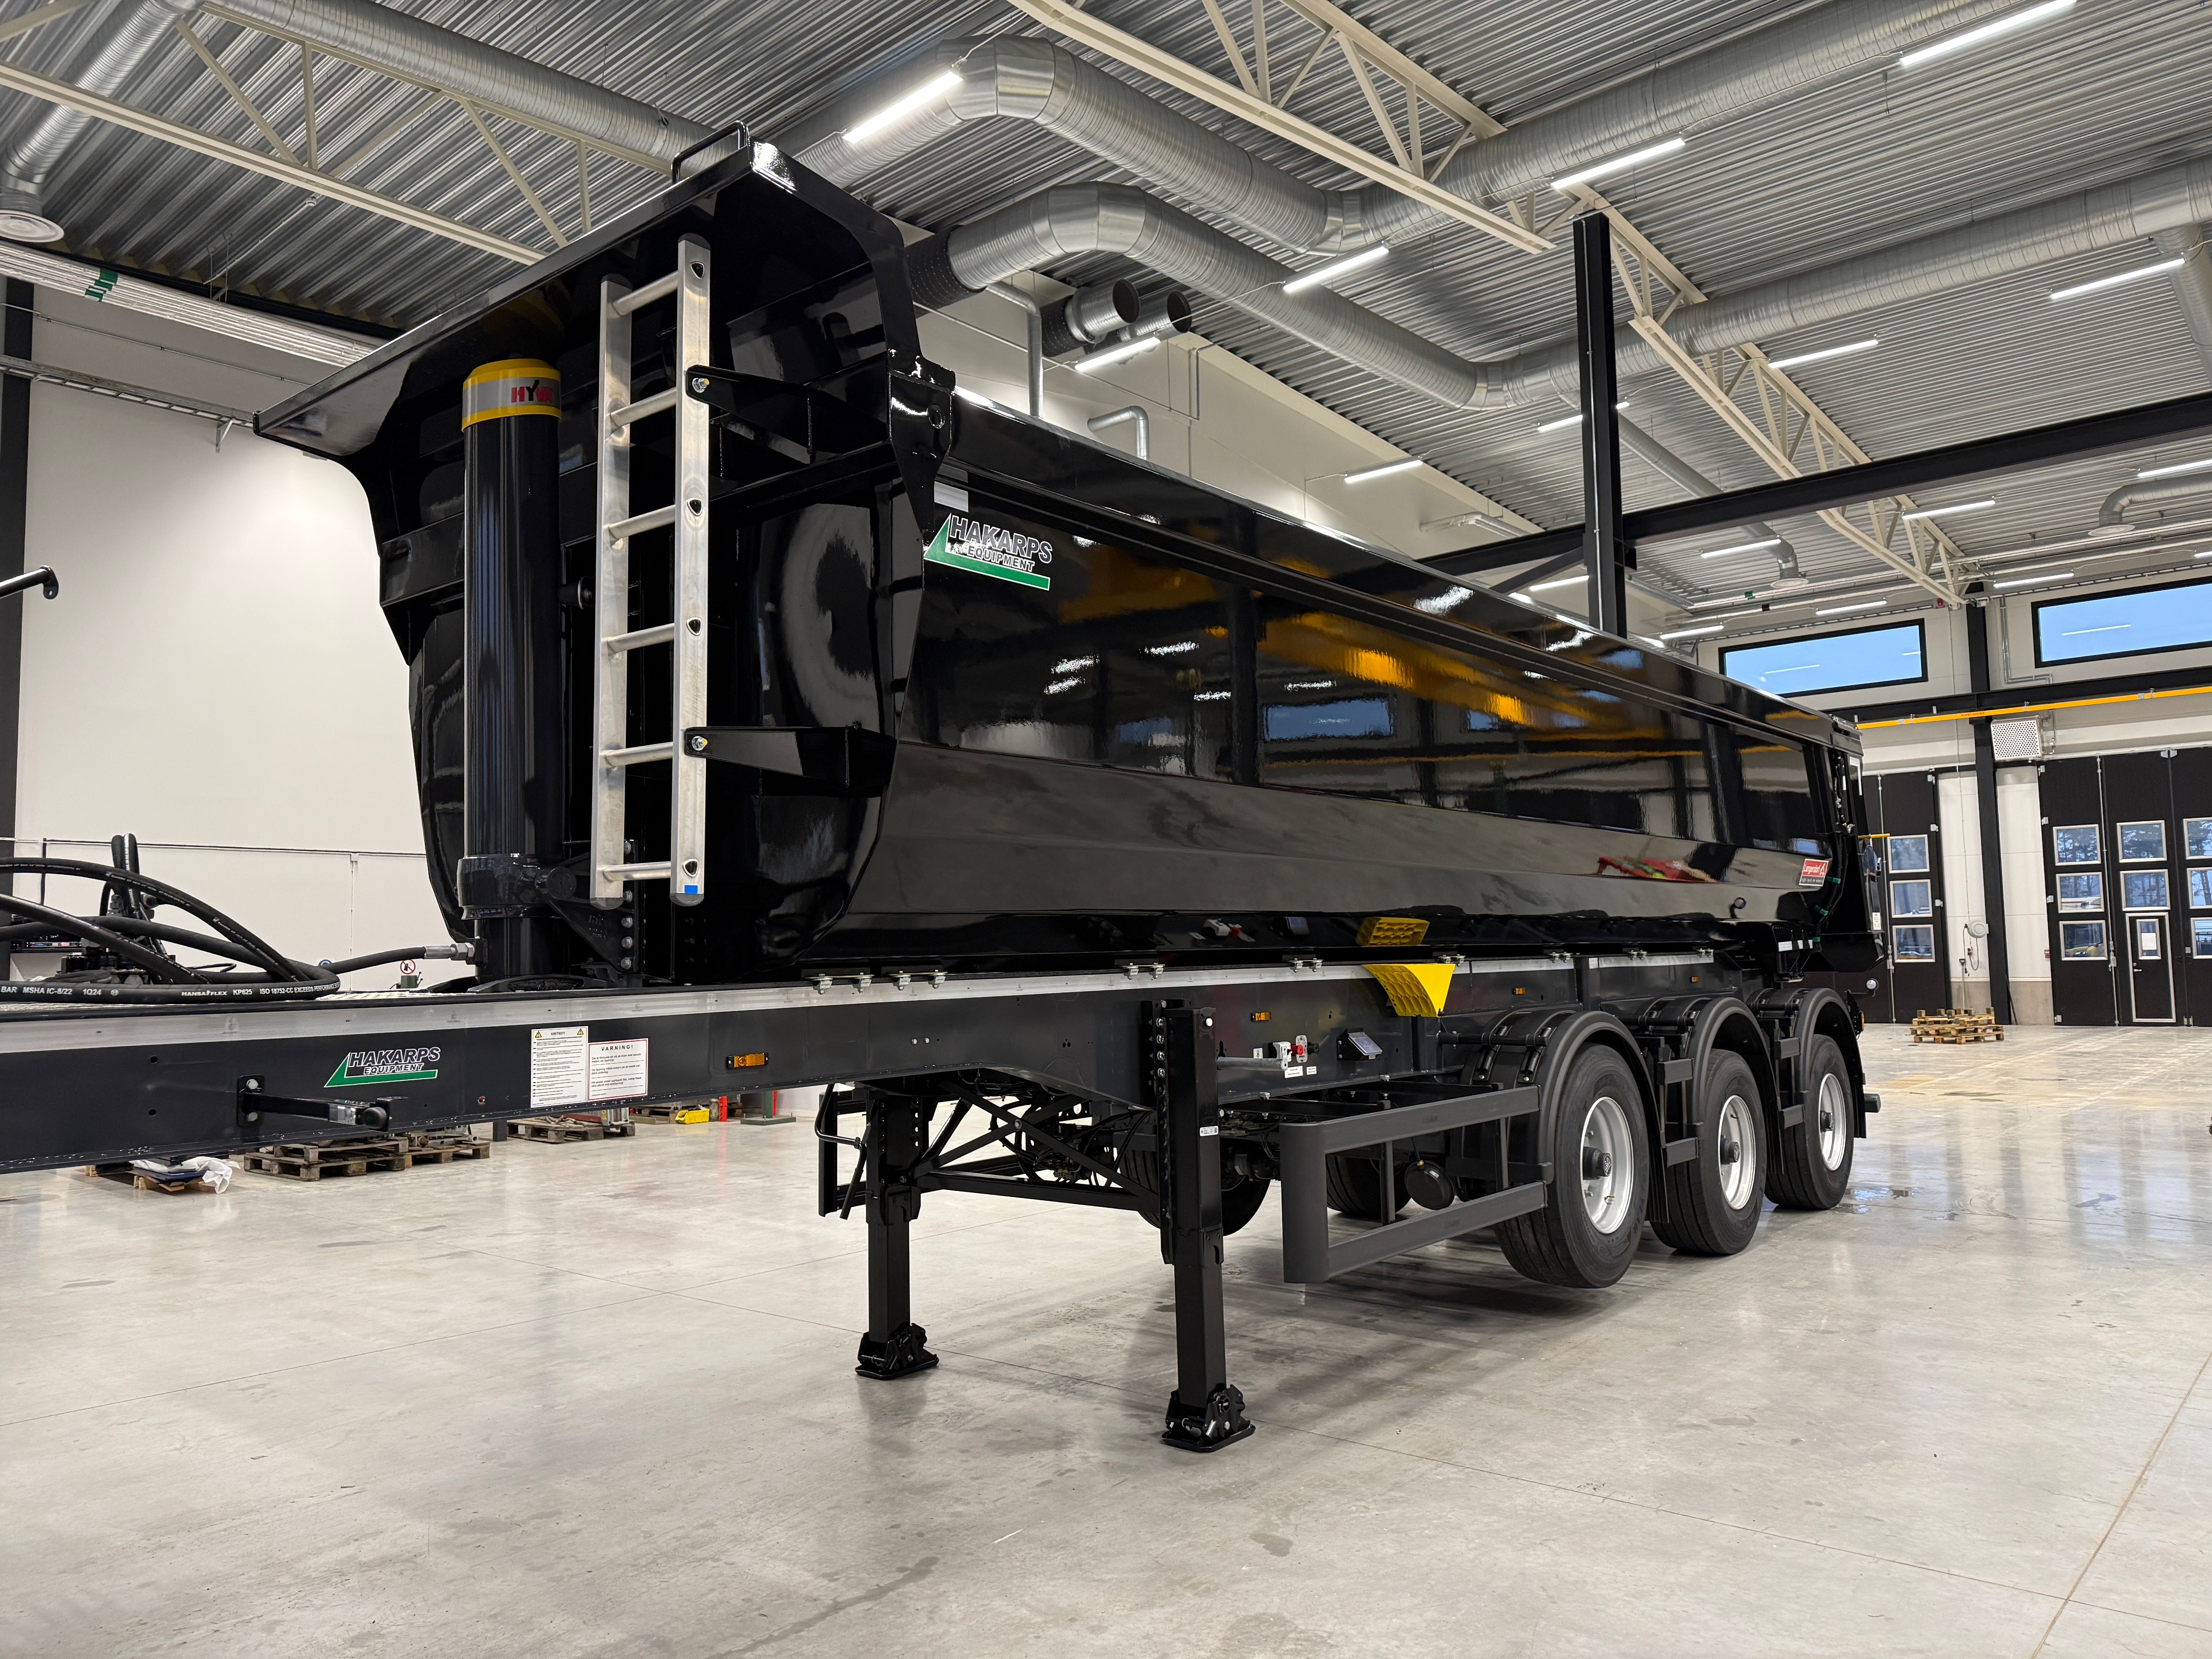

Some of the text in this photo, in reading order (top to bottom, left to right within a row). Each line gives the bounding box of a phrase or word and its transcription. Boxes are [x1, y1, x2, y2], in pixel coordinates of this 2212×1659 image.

[511, 379, 553, 403] HYVA
[949, 515, 1053, 563] HAKARPS
[967, 545, 1035, 572] EQUIPMENT
[348, 1047, 441, 1067] HAKARPS
[363, 1063, 425, 1075] EQUIPMENT
